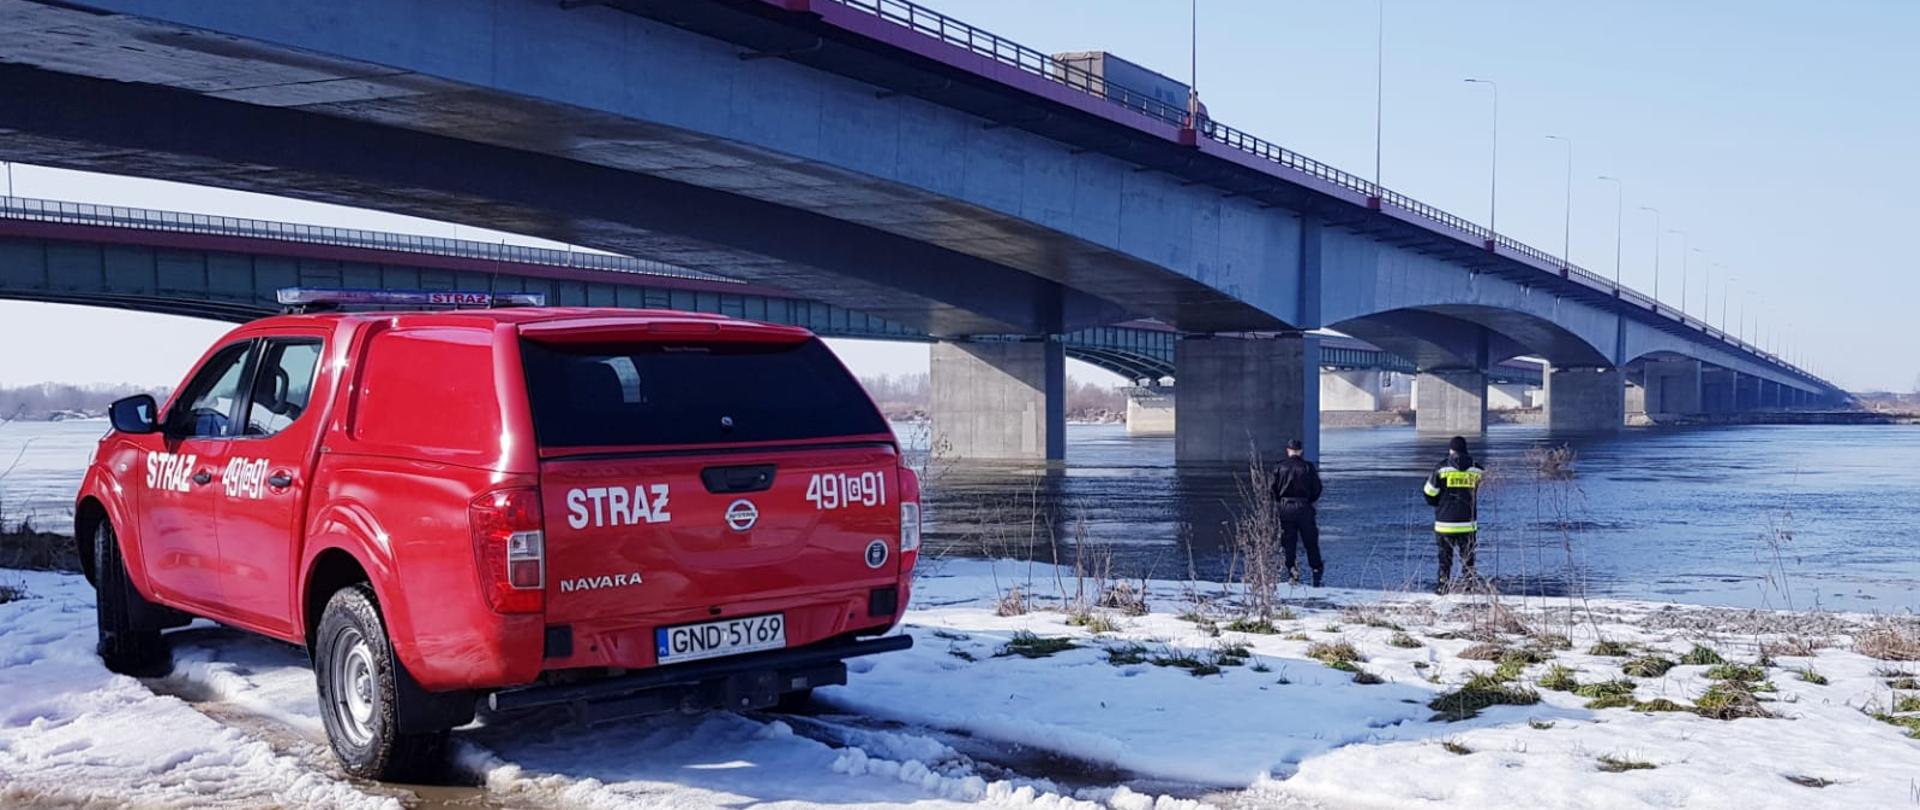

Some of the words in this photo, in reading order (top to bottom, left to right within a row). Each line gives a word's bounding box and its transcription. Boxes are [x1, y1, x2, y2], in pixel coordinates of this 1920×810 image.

[560, 572, 643, 592] NAVARA
[672, 626, 721, 653] GND
[729, 617, 781, 646] 5Y69
